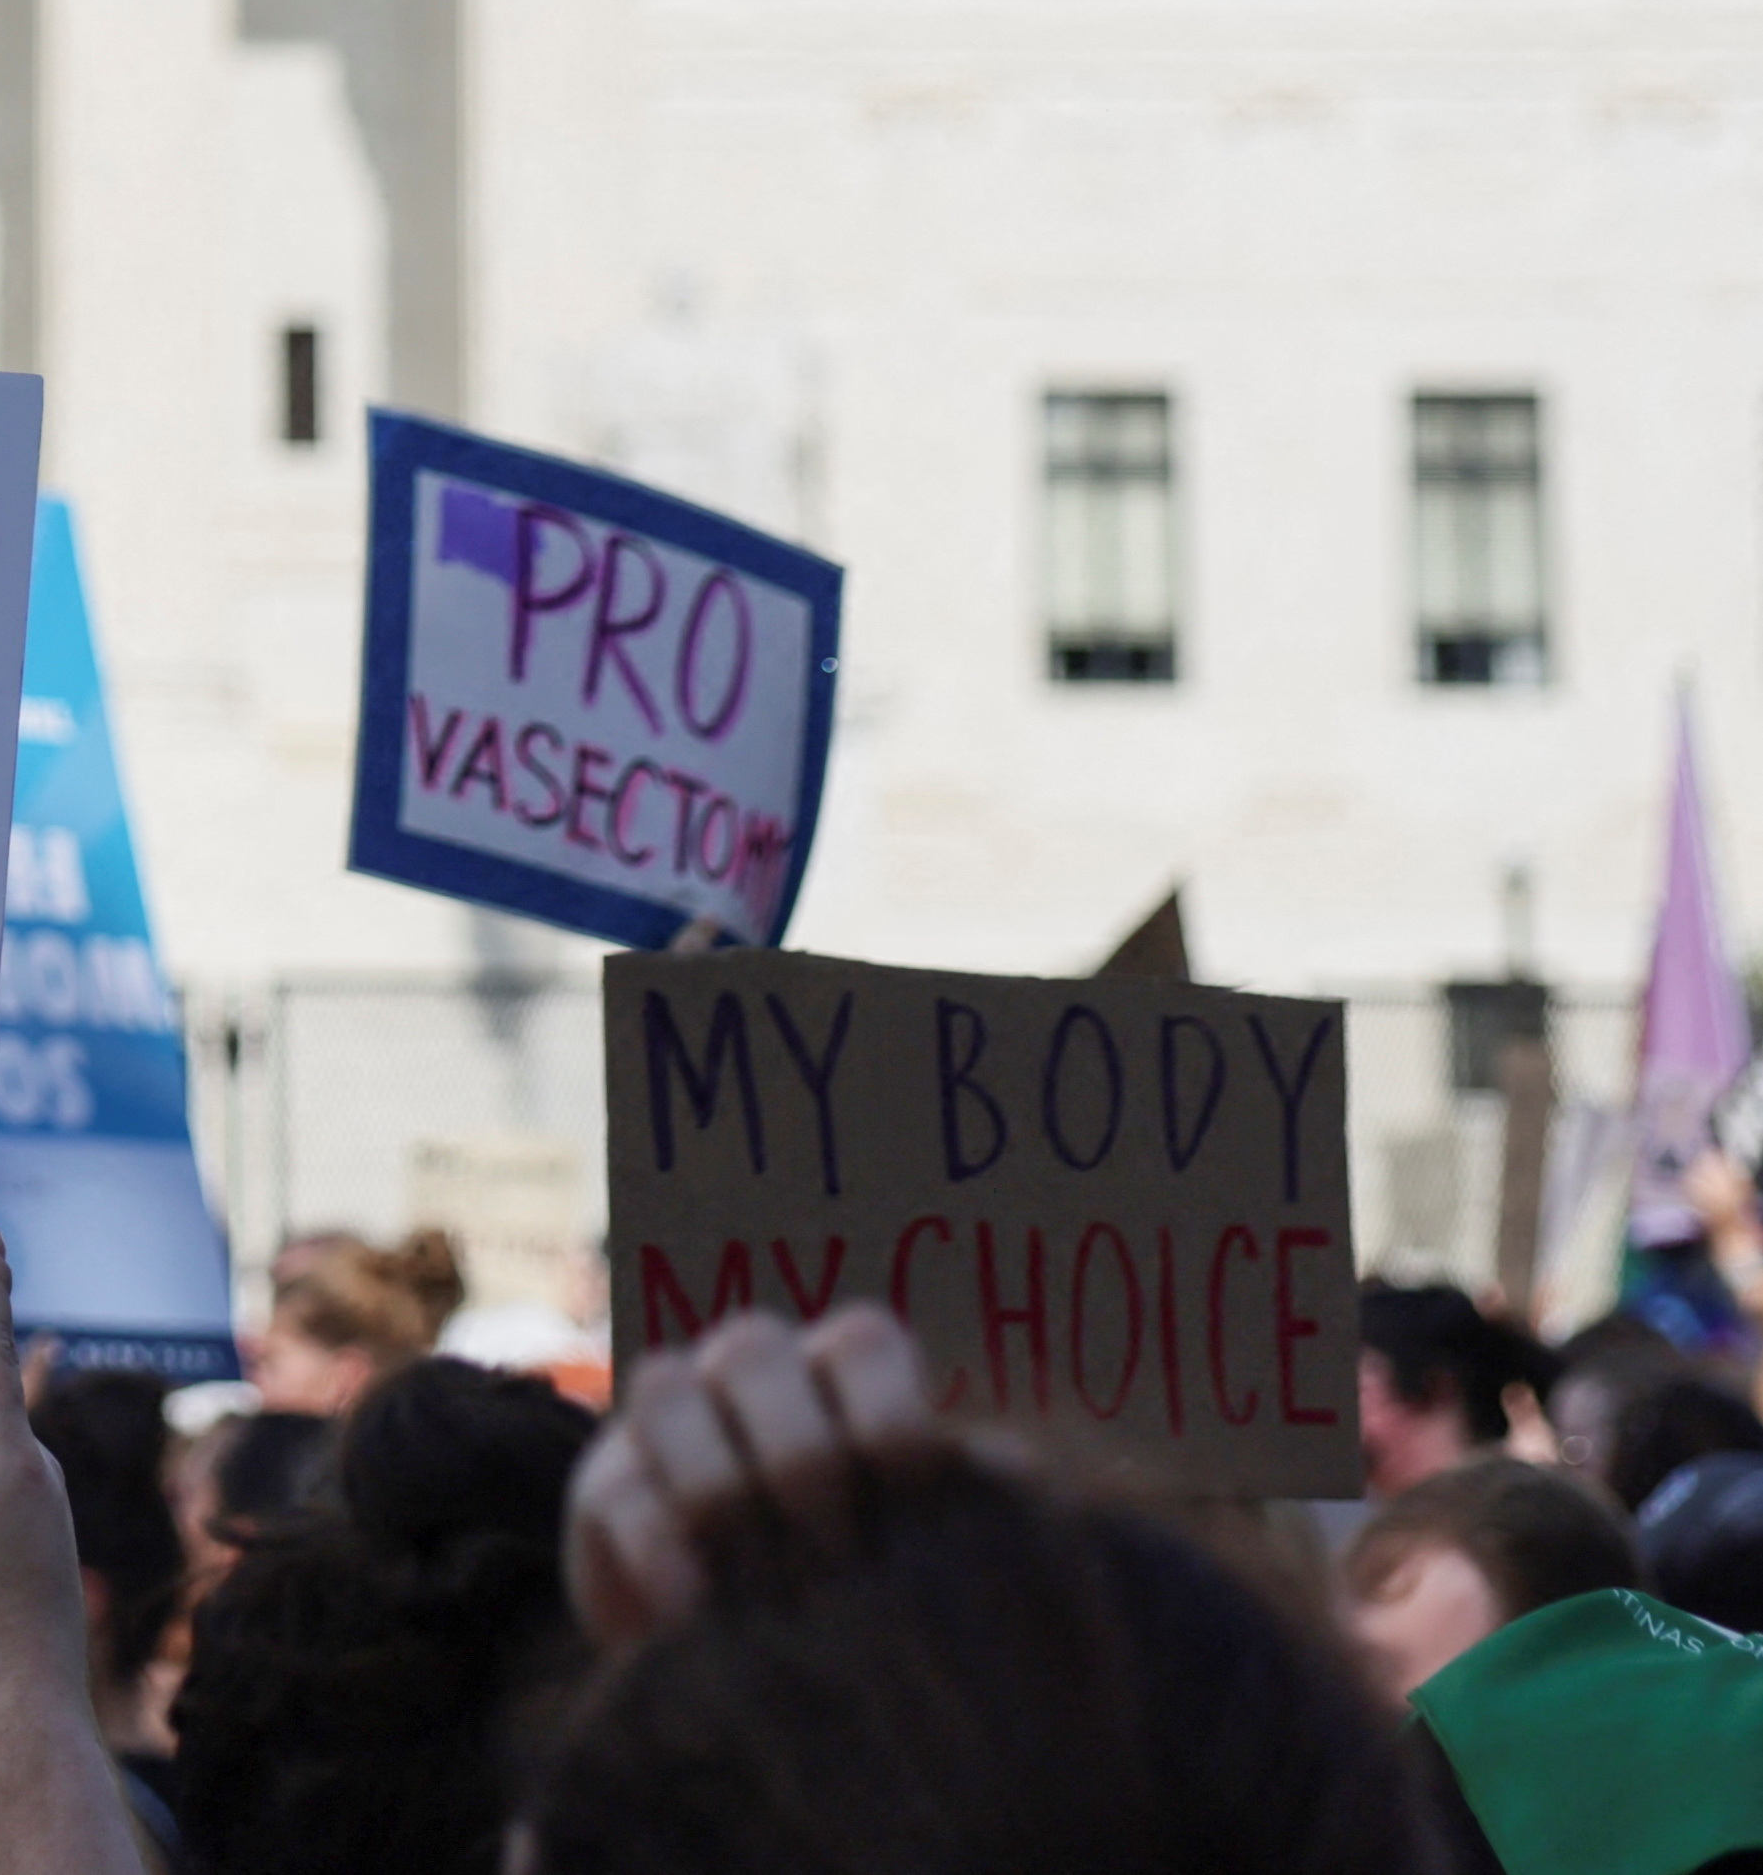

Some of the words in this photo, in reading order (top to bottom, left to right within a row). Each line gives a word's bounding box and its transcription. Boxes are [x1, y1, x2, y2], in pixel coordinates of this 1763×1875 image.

[507, 502, 753, 745] PRO
[642, 988, 854, 1197] MY
[935, 995, 1336, 1204] BODY
[887, 1213, 1342, 1438] CHOICE
